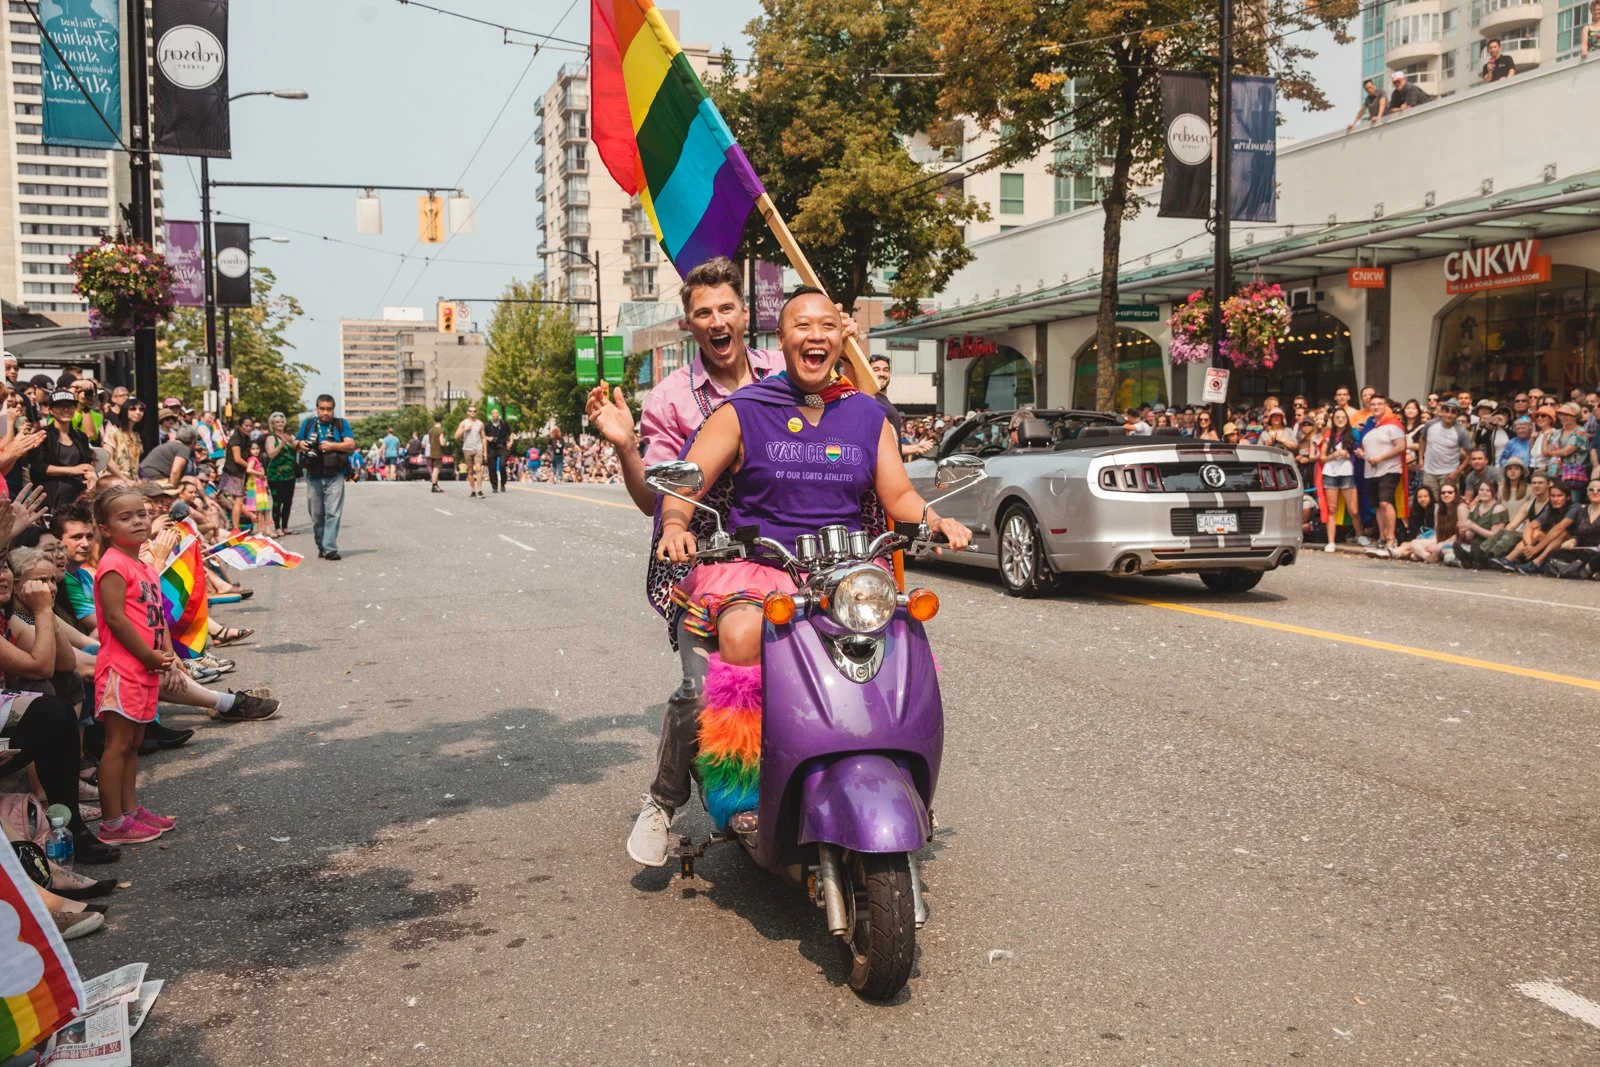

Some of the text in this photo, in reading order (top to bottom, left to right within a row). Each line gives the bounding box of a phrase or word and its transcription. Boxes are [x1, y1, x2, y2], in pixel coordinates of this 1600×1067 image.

[1173, 125, 1210, 146] robson
[1443, 239, 1534, 282] CNKW
[1352, 271, 1384, 281] CNKW
[1521, 273, 1540, 282] STORE
[766, 442, 805, 462] VAN
[775, 470, 854, 482] OF OUR LGBTQ ATHLETES
